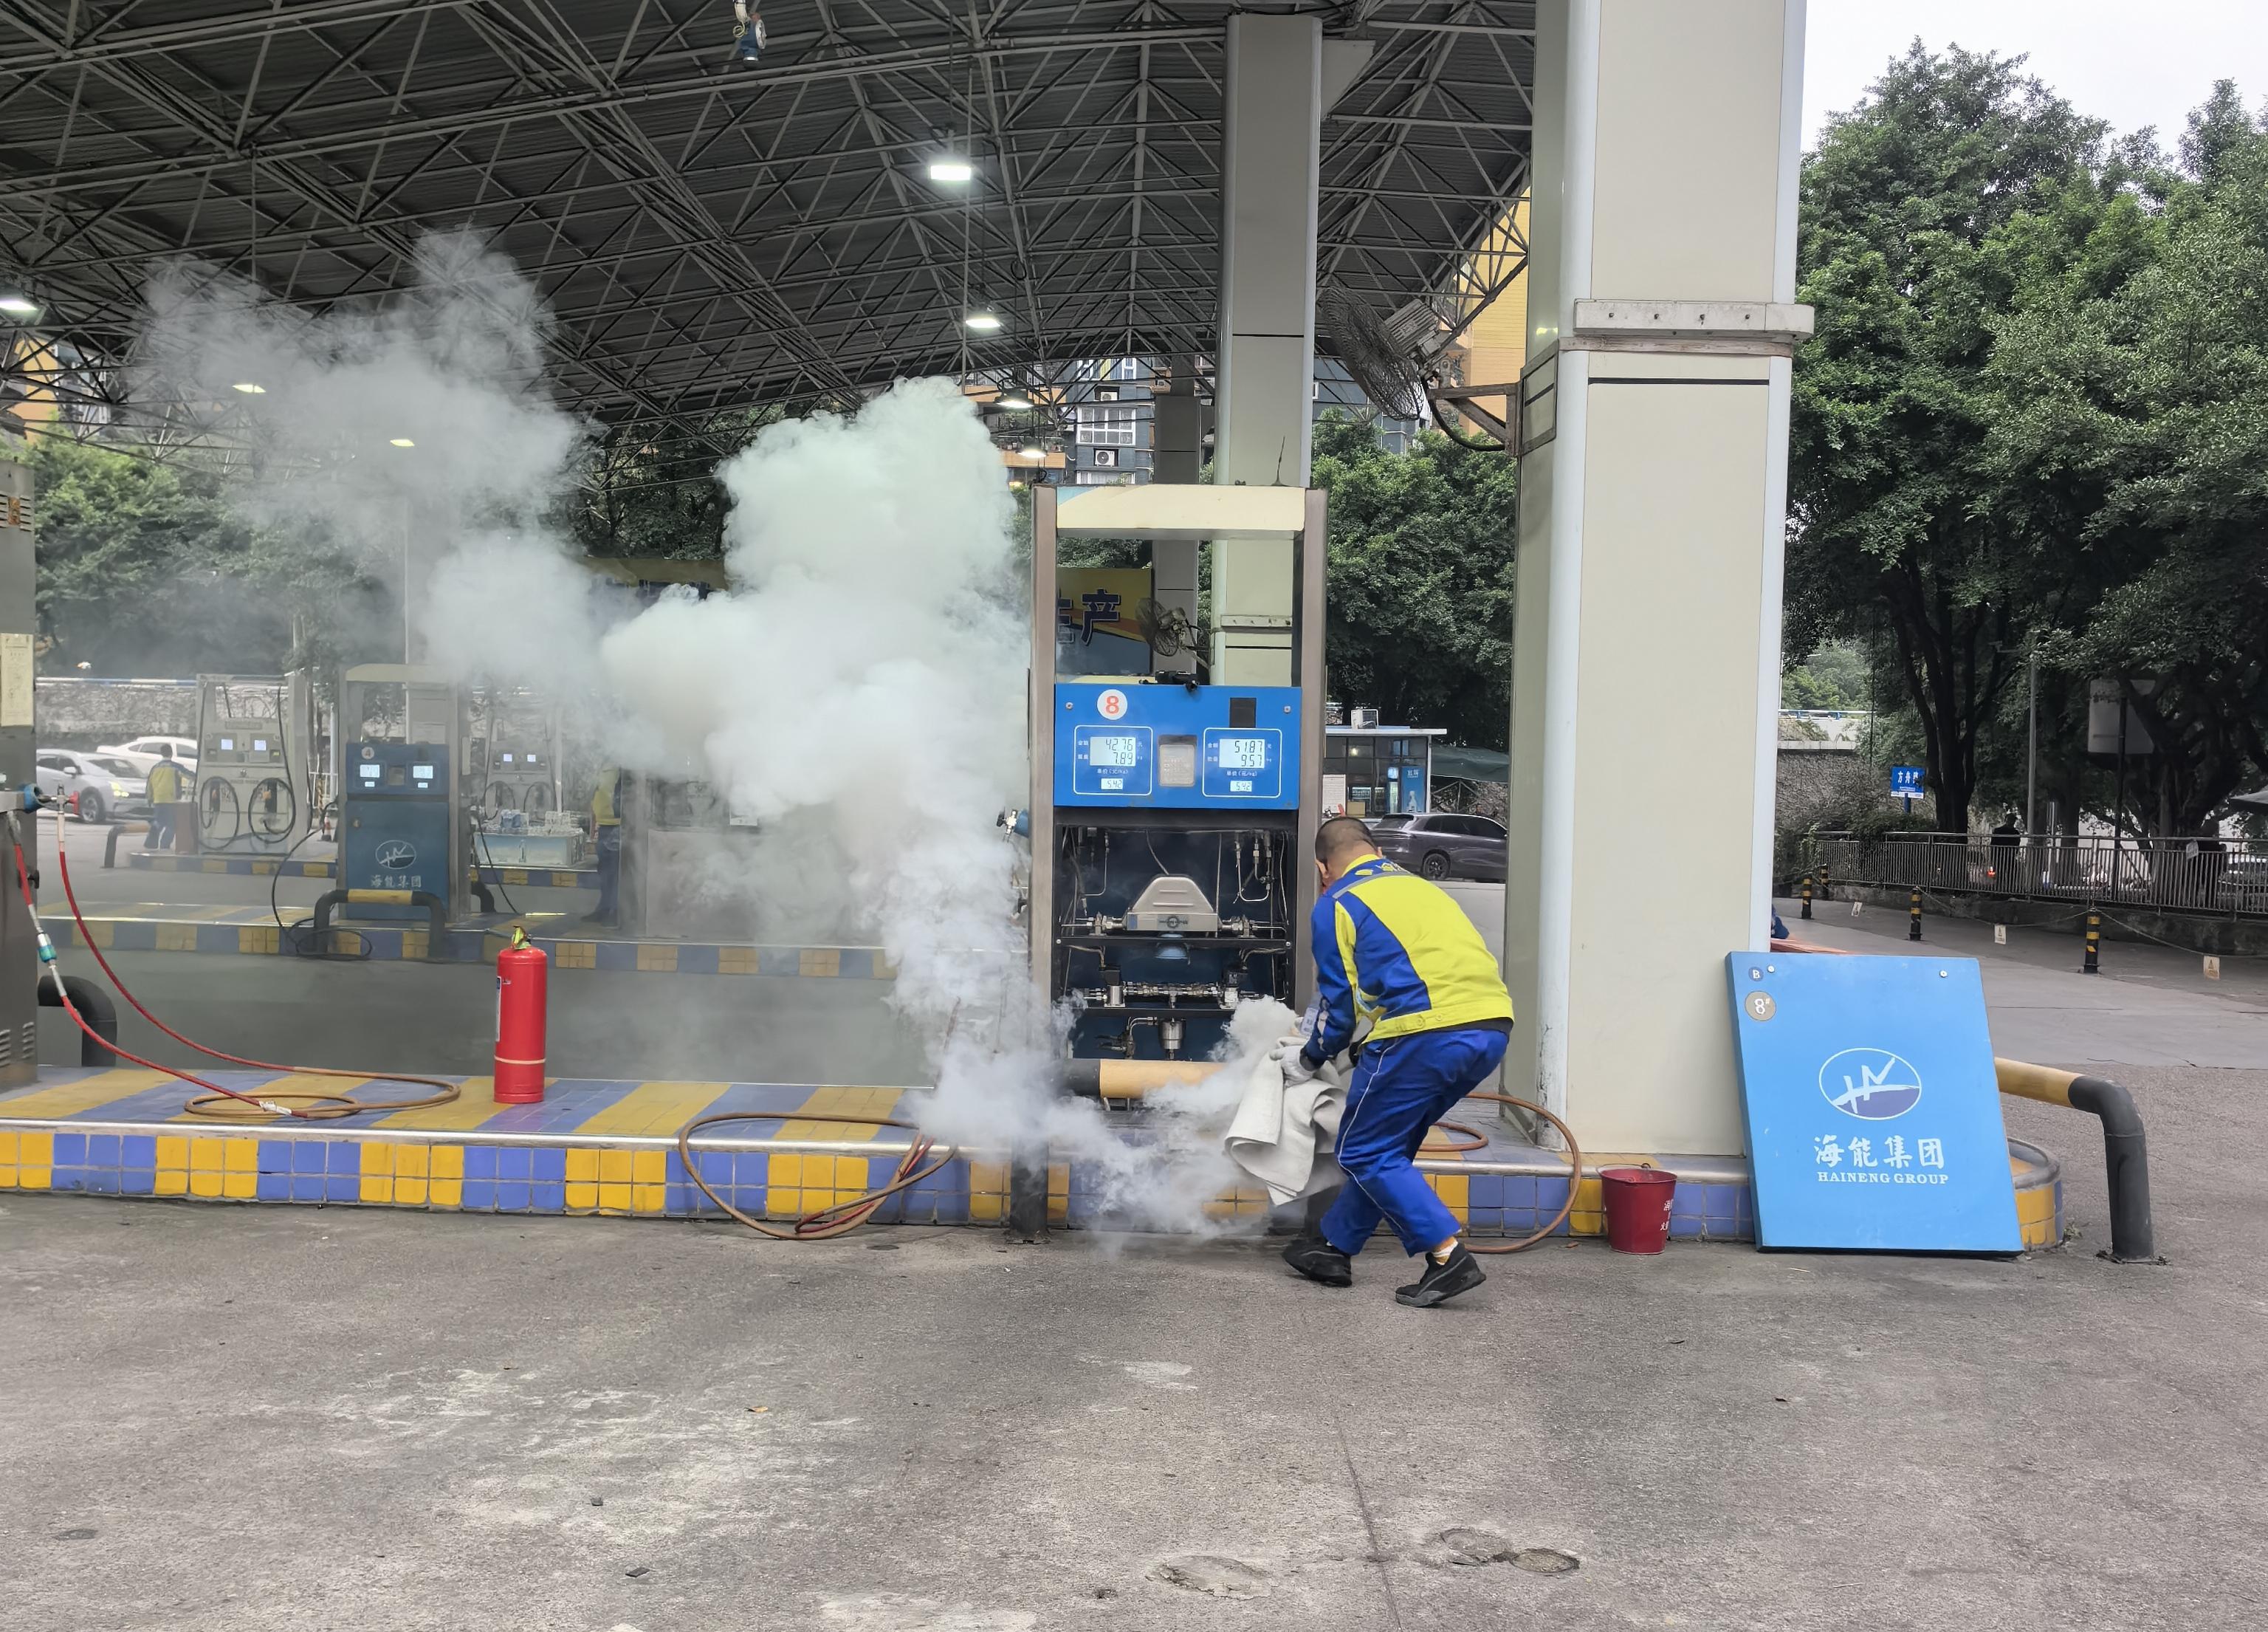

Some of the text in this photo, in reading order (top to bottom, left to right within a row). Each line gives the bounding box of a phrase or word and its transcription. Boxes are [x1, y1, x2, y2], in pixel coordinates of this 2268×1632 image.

[1105, 696, 1119, 714] 8
[1814, 1134, 1945, 1169] 海能集团
[1818, 1171, 1949, 1184] HAINENG GROUP
